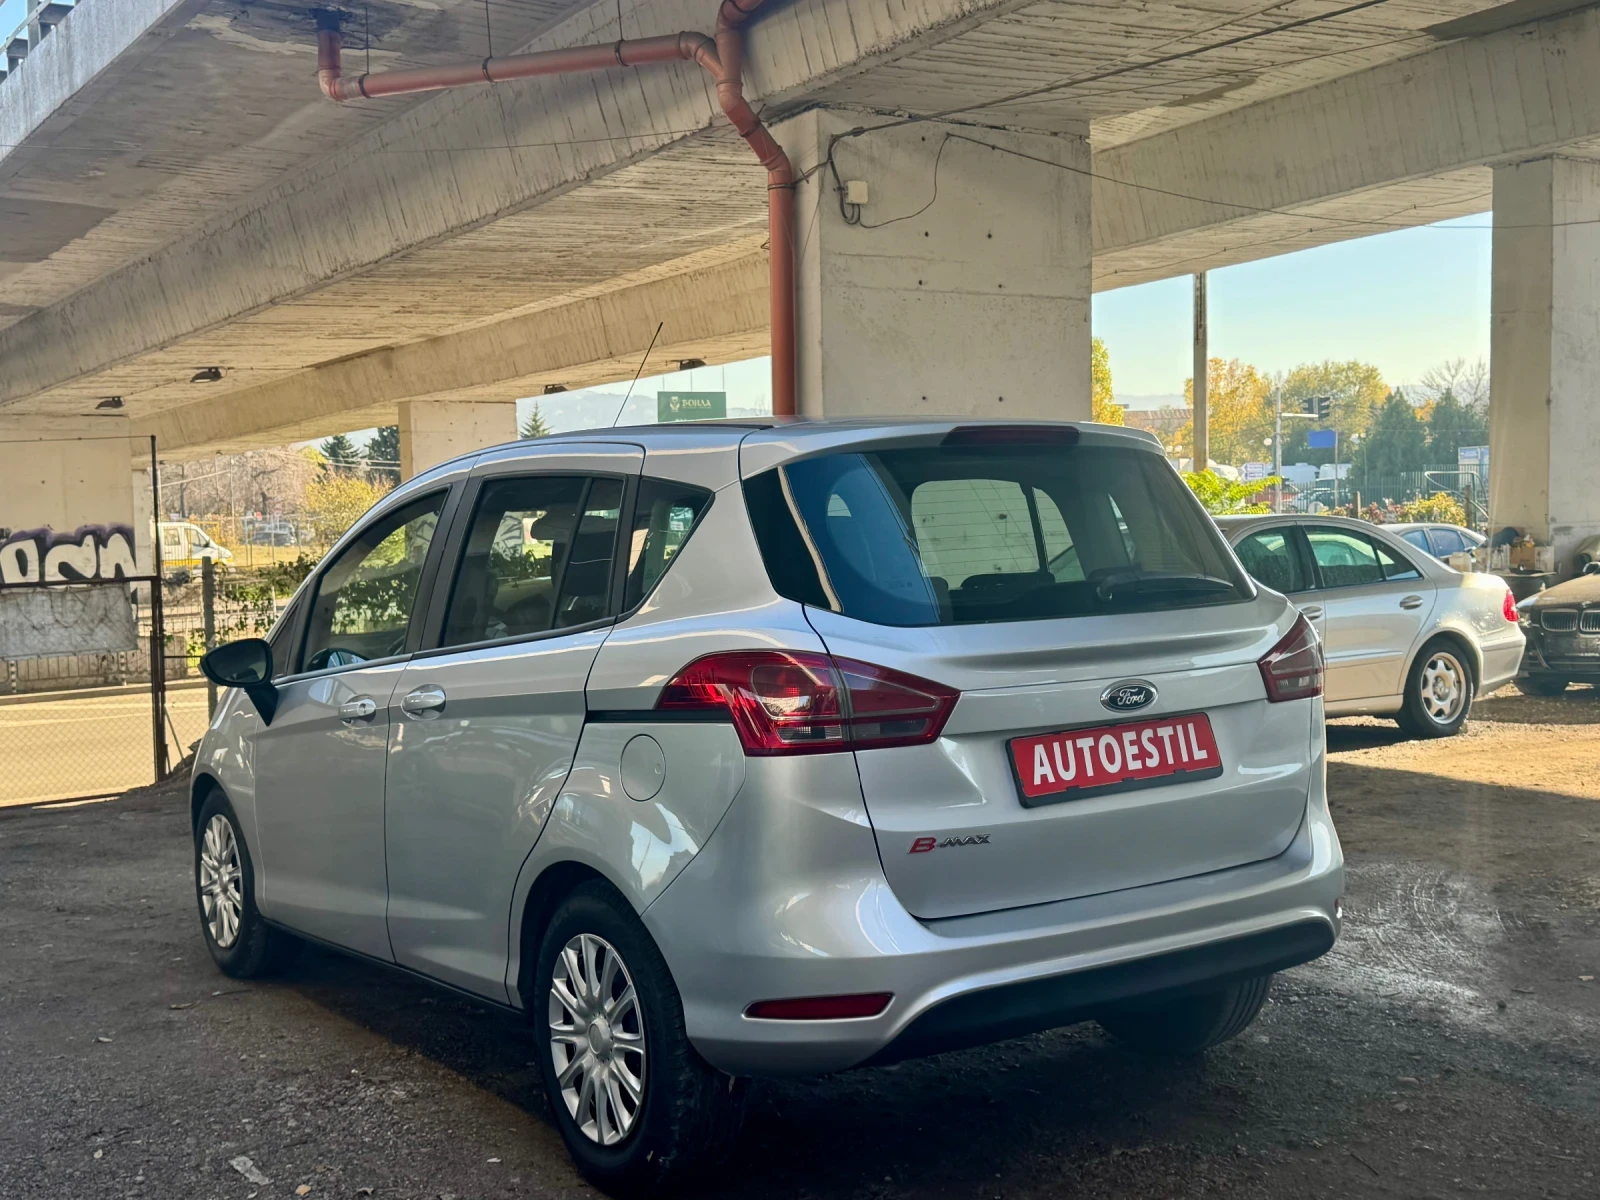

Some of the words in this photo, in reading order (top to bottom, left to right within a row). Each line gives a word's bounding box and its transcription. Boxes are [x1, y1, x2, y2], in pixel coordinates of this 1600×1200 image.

[1117, 688, 1146, 706] Ford
[1033, 722, 1208, 786] AUTOESTIL
[907, 833, 992, 854] B-MAX
